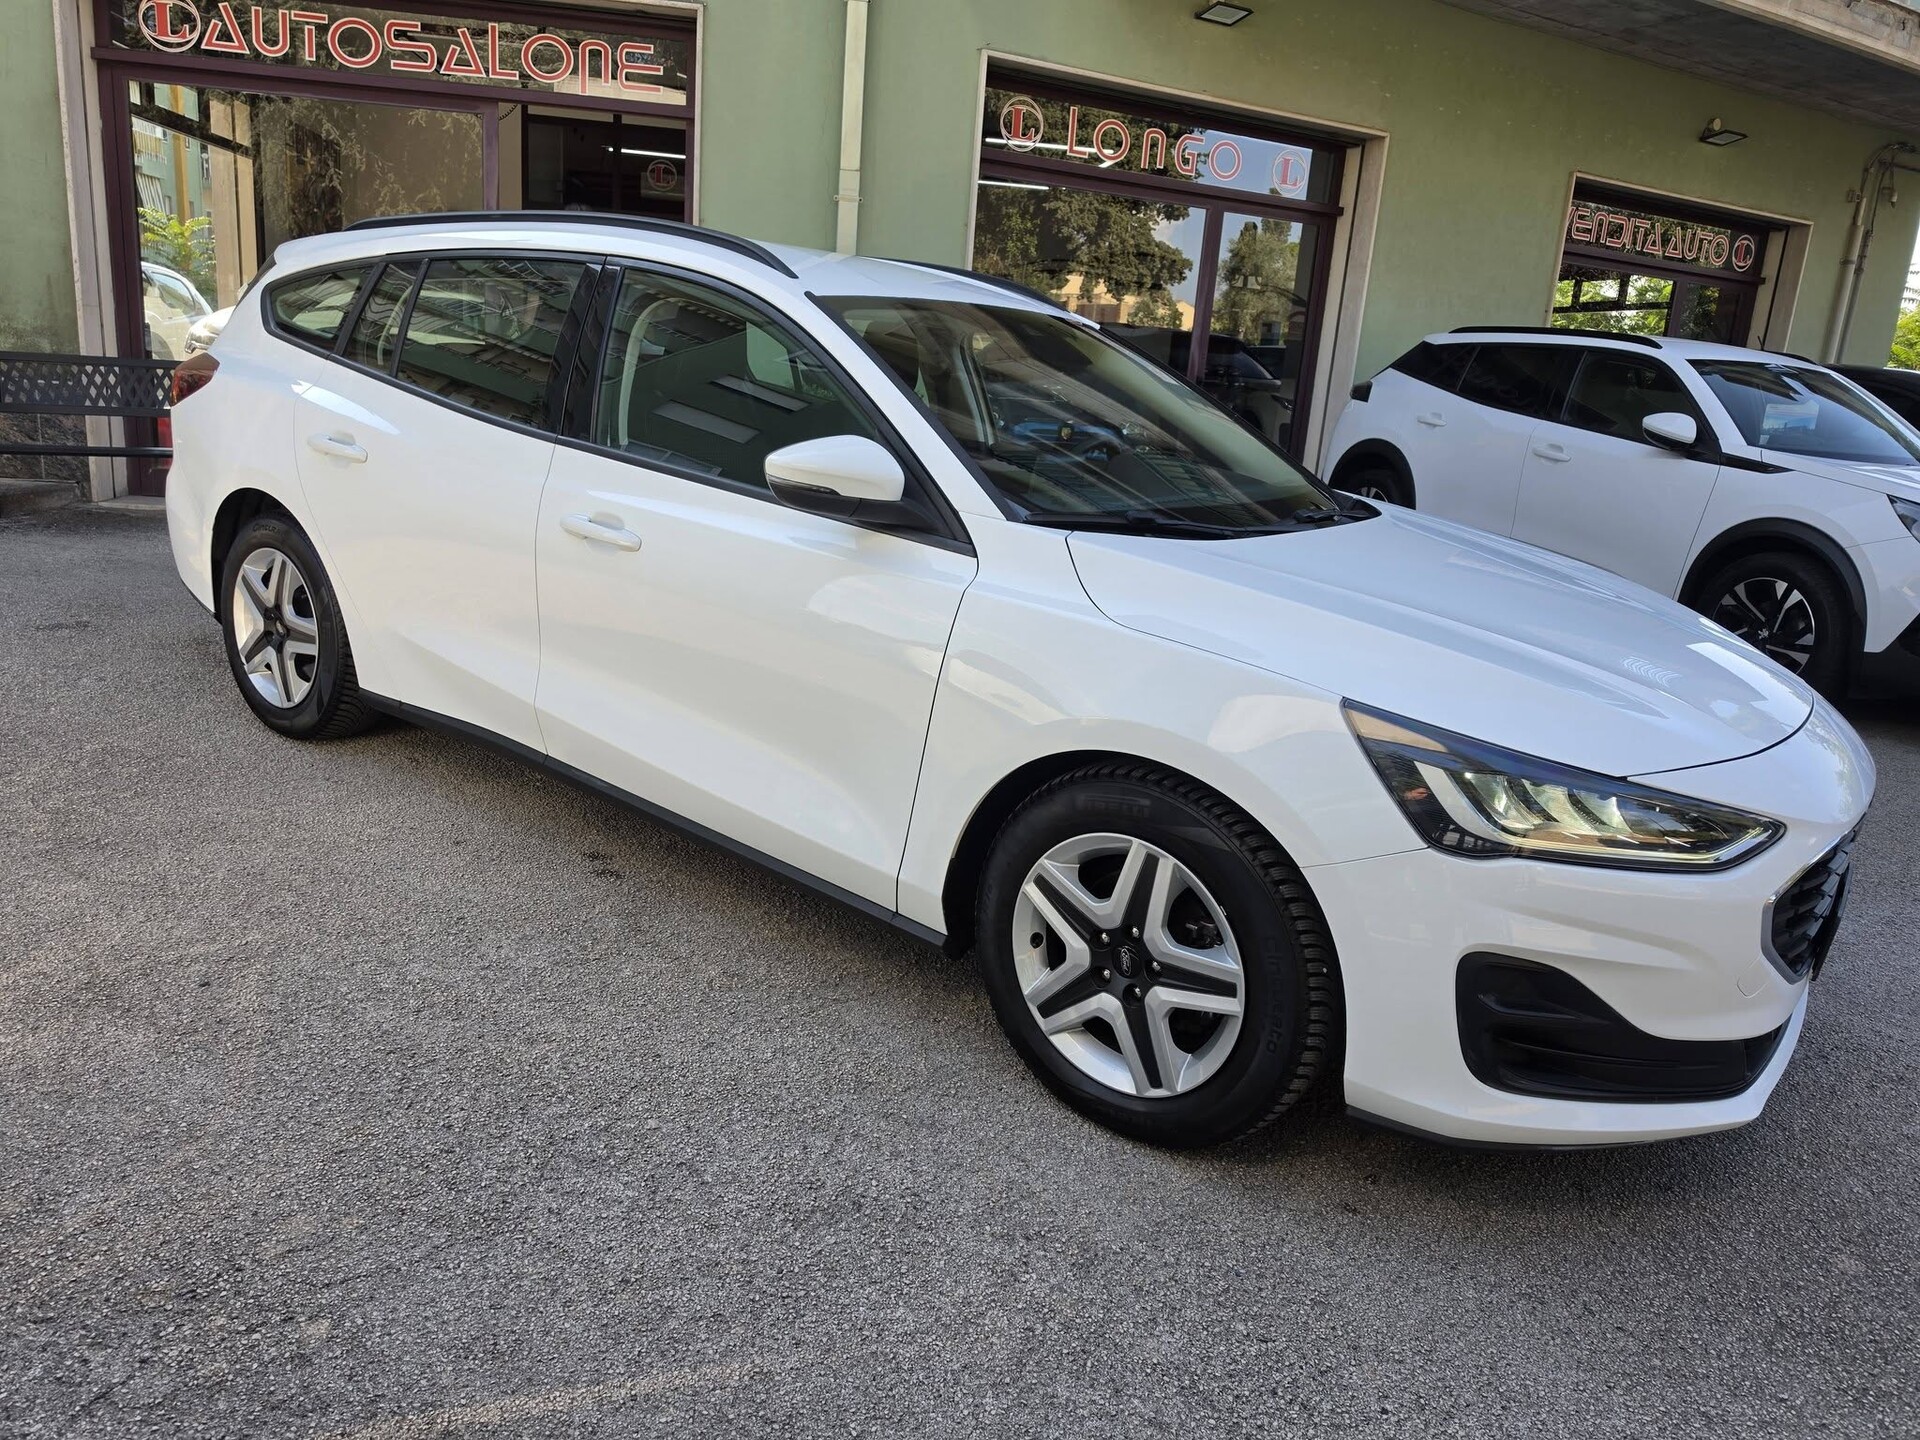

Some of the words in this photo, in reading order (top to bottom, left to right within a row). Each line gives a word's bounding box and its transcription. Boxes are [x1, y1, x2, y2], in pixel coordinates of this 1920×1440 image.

[201, 1, 664, 95] AUTOSALONE
[1066, 105, 1243, 181] LONGO
[1664, 226, 1730, 266] AUTO
